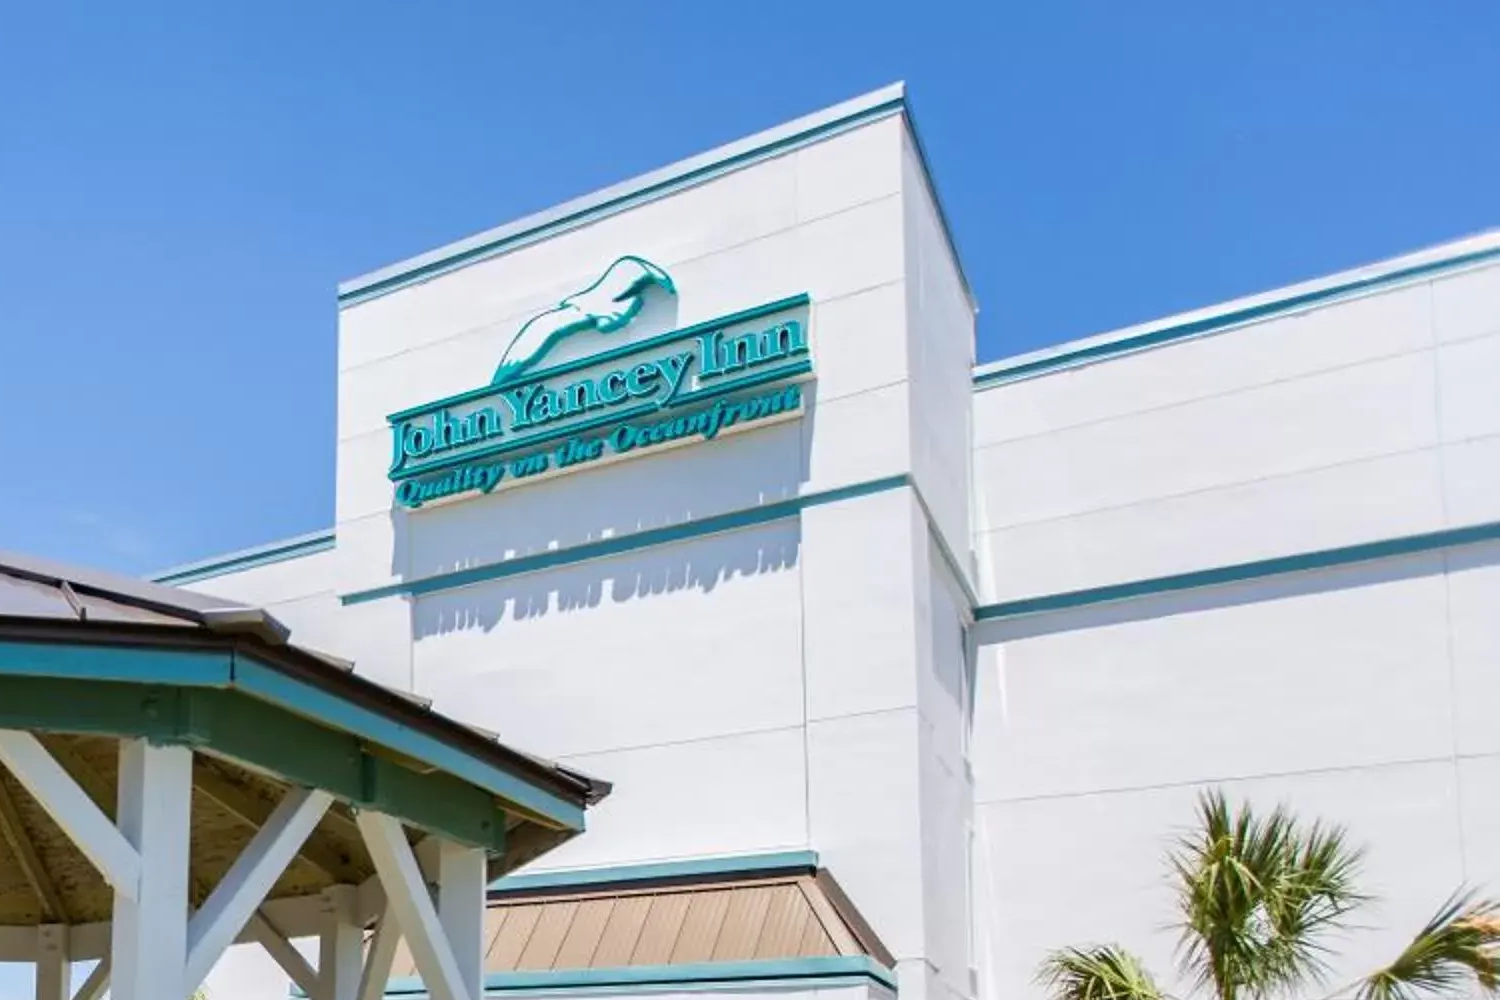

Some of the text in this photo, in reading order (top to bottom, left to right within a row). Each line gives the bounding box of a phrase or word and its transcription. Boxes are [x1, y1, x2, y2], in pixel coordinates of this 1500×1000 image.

[389, 319, 809, 475] John Yancey Inn
[396, 383, 802, 508] Quality on the Oceanfront
